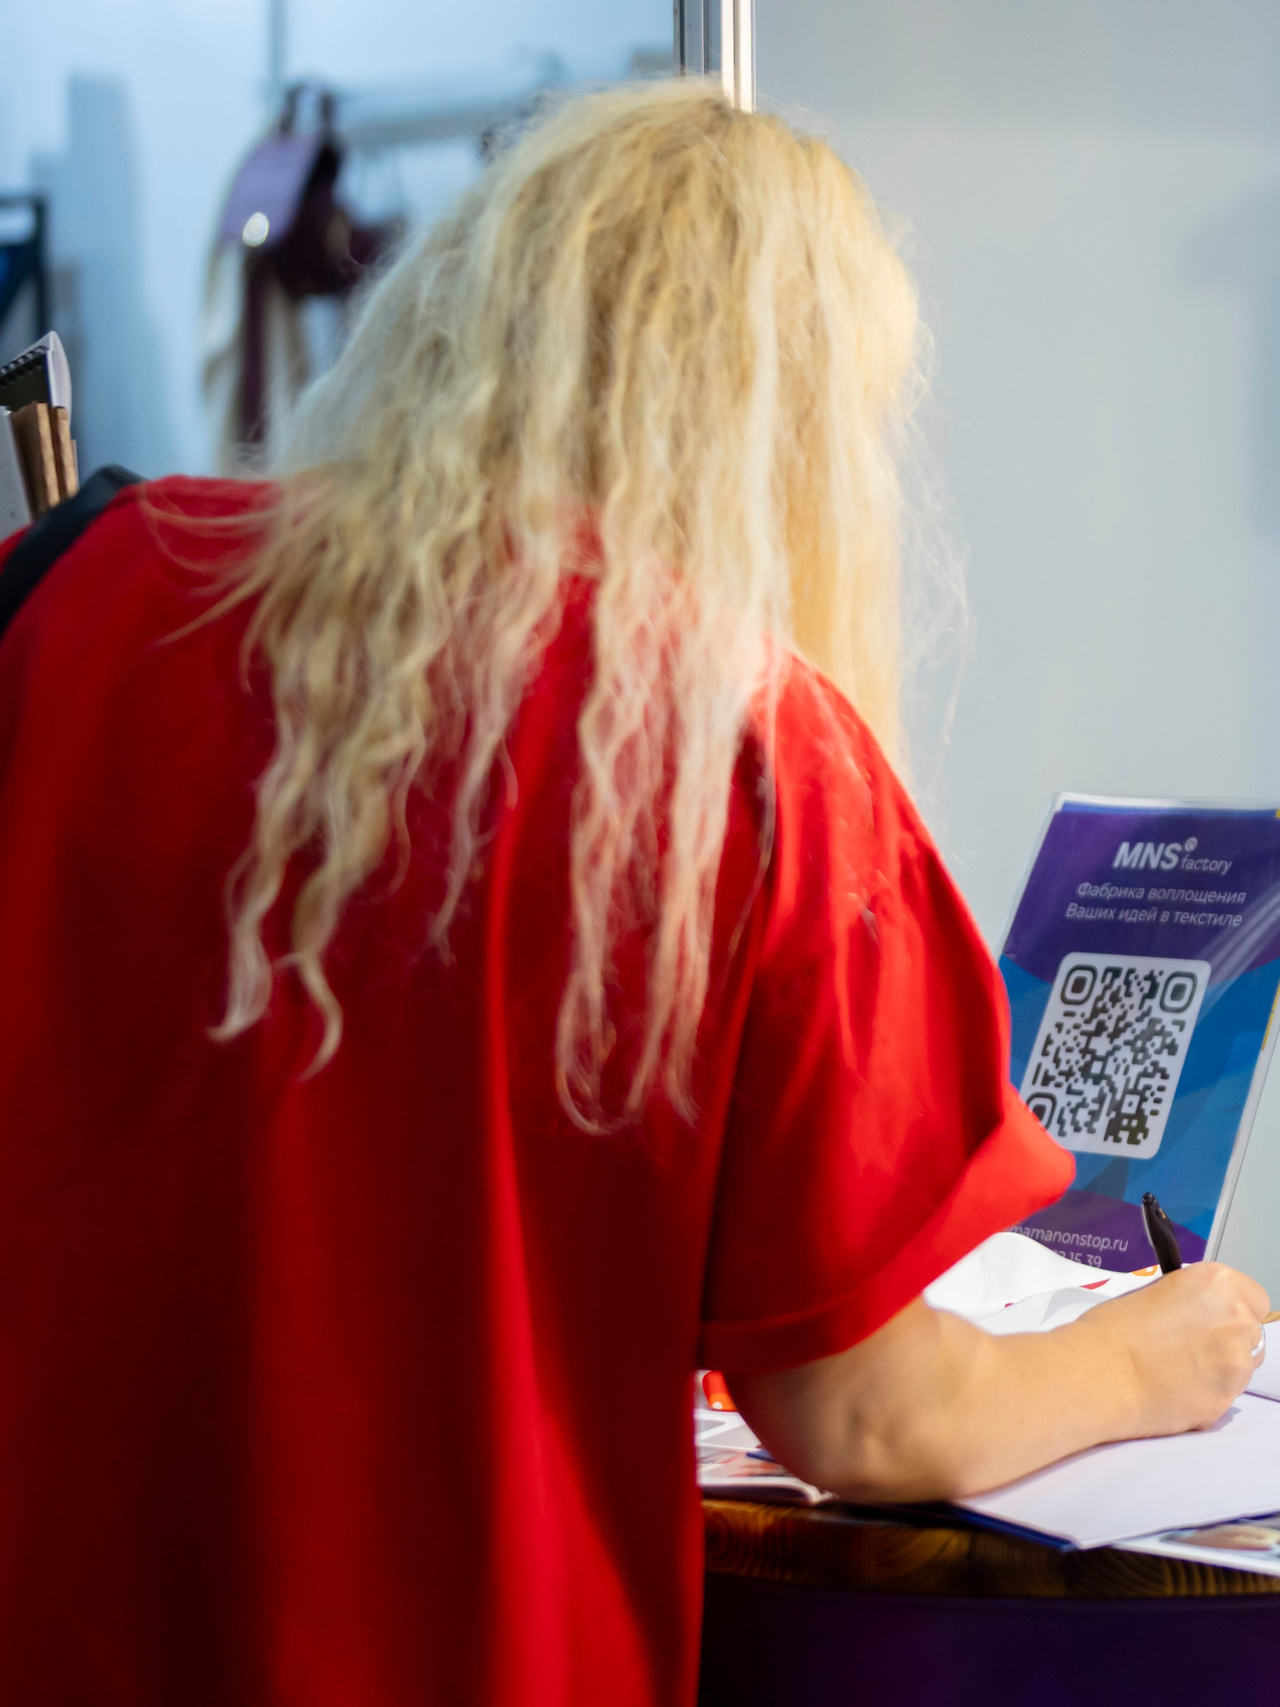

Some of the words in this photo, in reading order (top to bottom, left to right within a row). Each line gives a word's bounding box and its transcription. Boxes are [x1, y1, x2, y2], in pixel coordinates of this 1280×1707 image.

[1113, 842, 1182, 870] MNS
[1180, 854, 1232, 875] factory
[1076, 881, 1145, 900] Фабрика
[1148, 887, 1246, 904] воплощения
[1066, 902, 1117, 919] Ваших
[1118, 906, 1157, 922] идей
[1160, 910, 1169, 922] в
[1174, 911, 1243, 927] текстиле
[1006, 1226, 1128, 1252] mamanonstop.ru
[1086, 1254, 1103, 1268] 39
